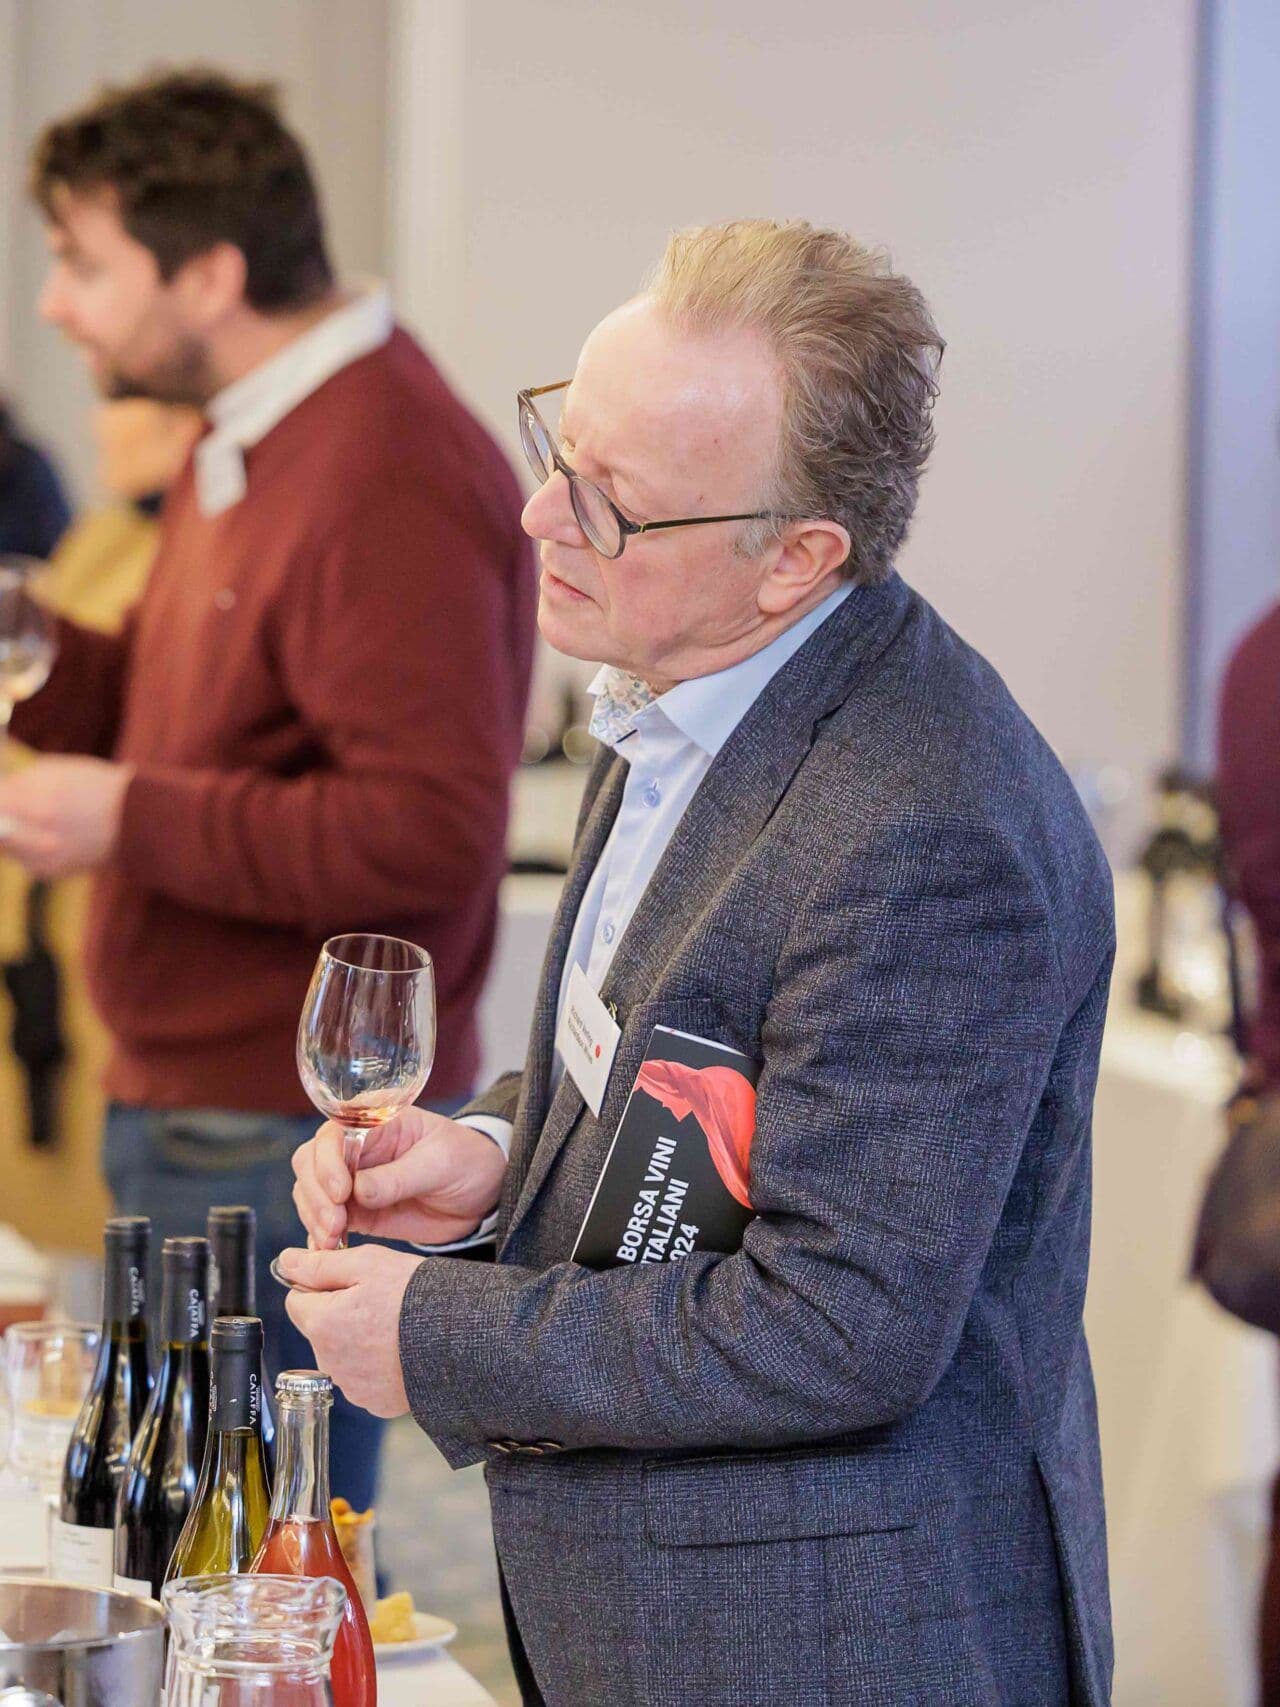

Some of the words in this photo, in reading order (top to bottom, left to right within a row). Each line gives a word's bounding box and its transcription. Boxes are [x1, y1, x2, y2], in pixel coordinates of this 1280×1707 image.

[616, 1190, 660, 1262] BORSA
[644, 1136, 677, 1181] VINI
[249, 1373, 257, 1425] CAIAFFA
